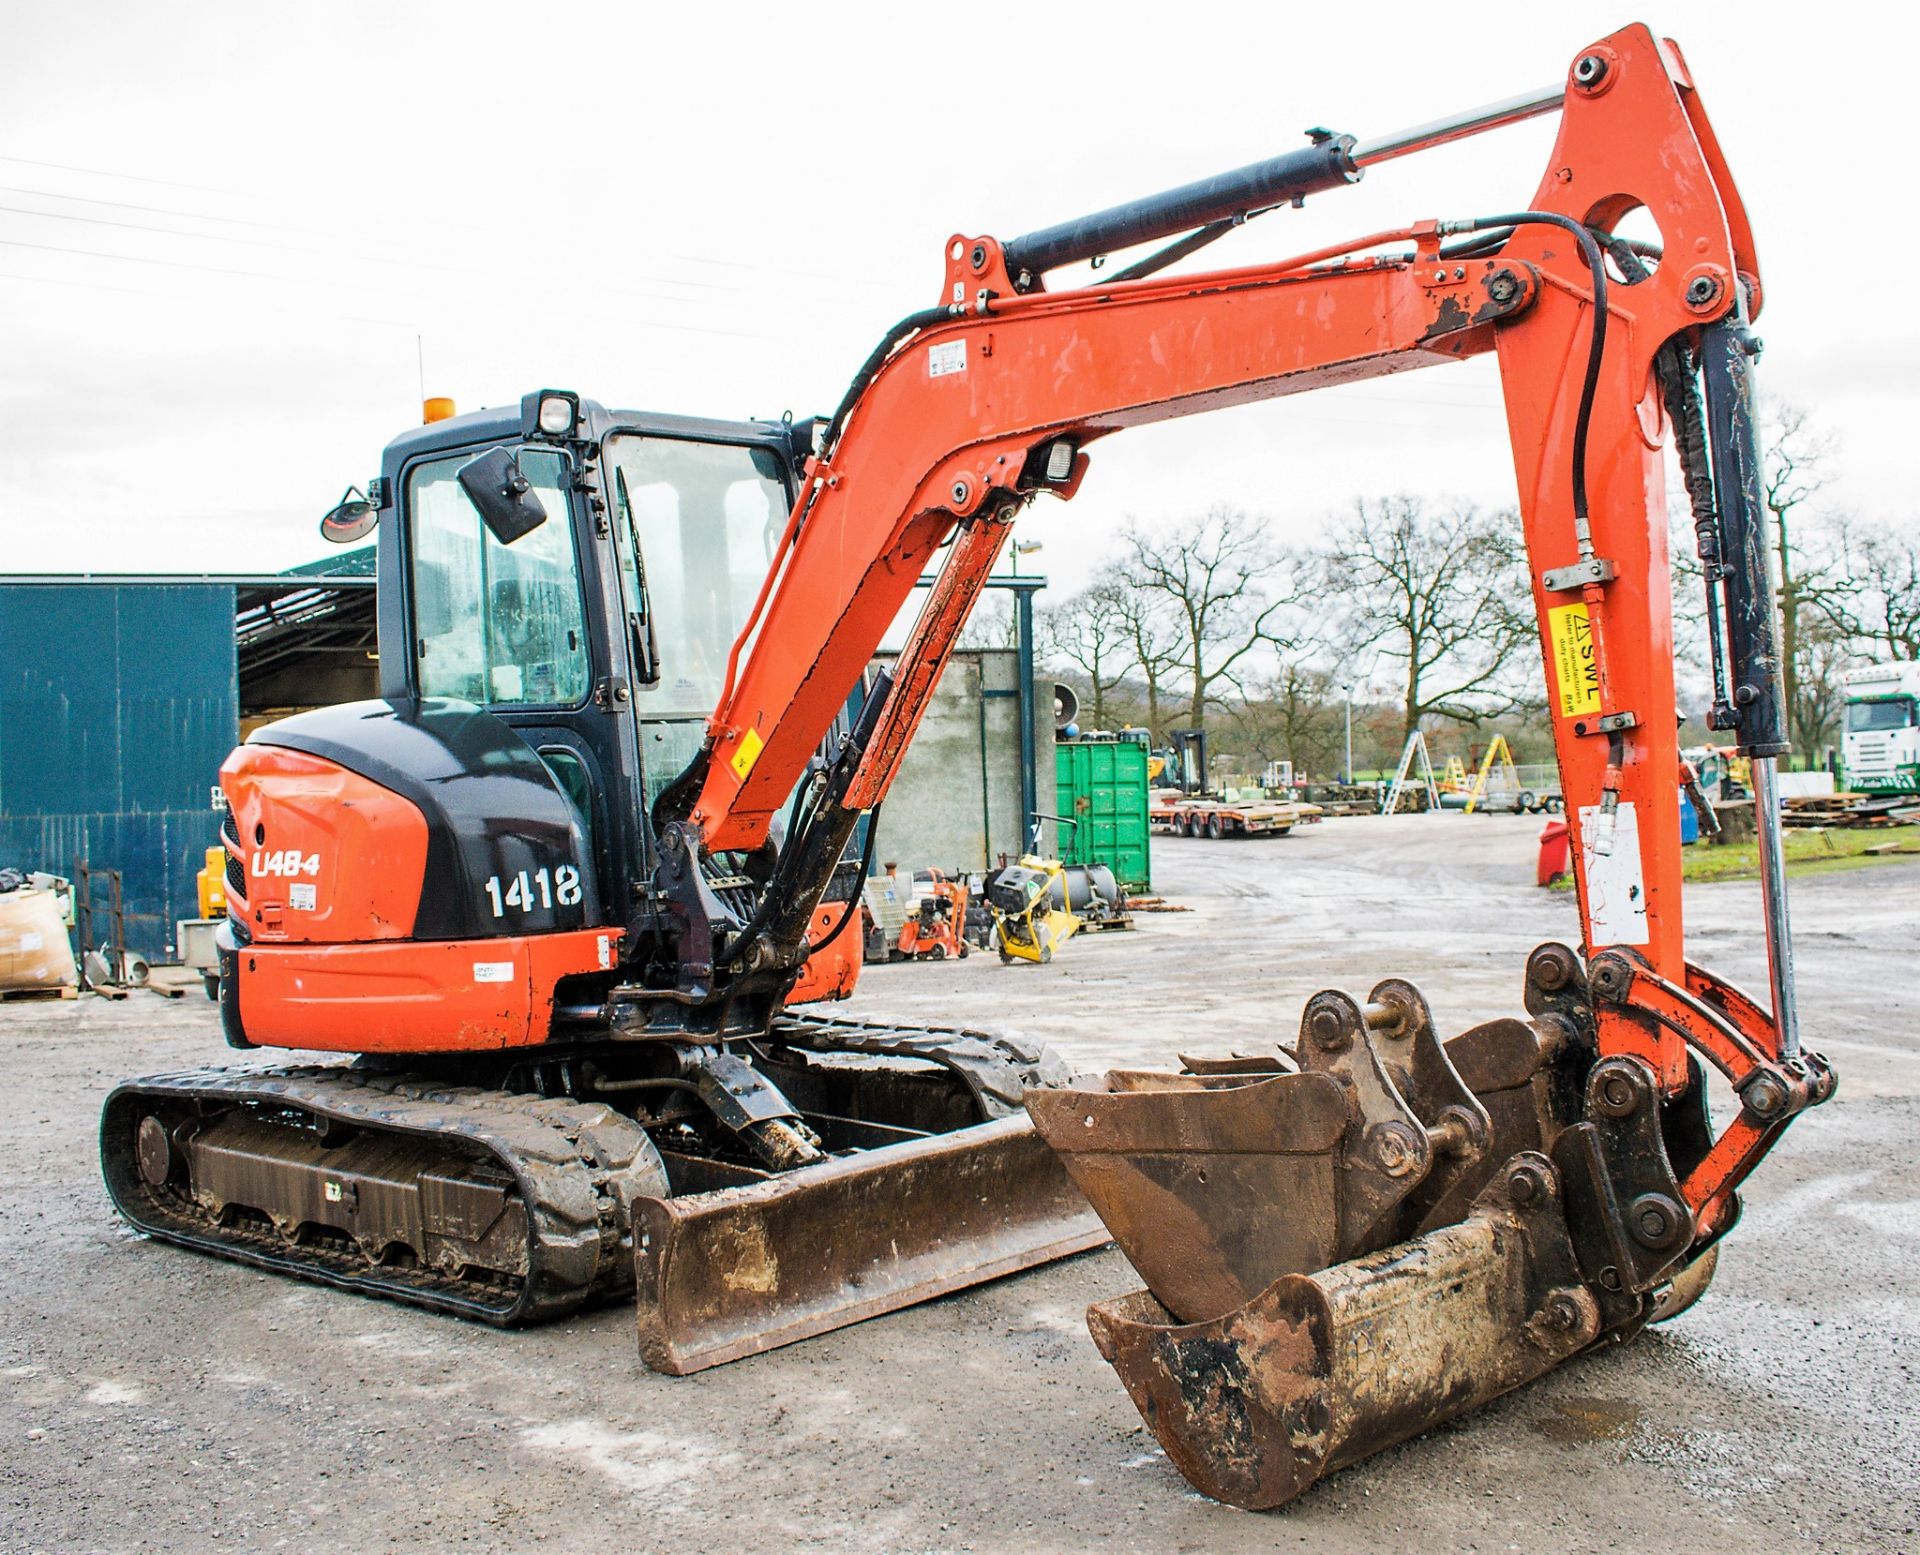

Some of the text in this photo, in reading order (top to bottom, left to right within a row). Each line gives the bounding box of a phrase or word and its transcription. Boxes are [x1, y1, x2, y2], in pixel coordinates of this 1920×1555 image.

[1560, 638, 1568, 656] duty
[1565, 613, 1583, 704] Refer to manufacturers
[1582, 645, 1599, 700] SWL
[251, 850, 320, 878] U48-4
[485, 865, 582, 917] 1418
